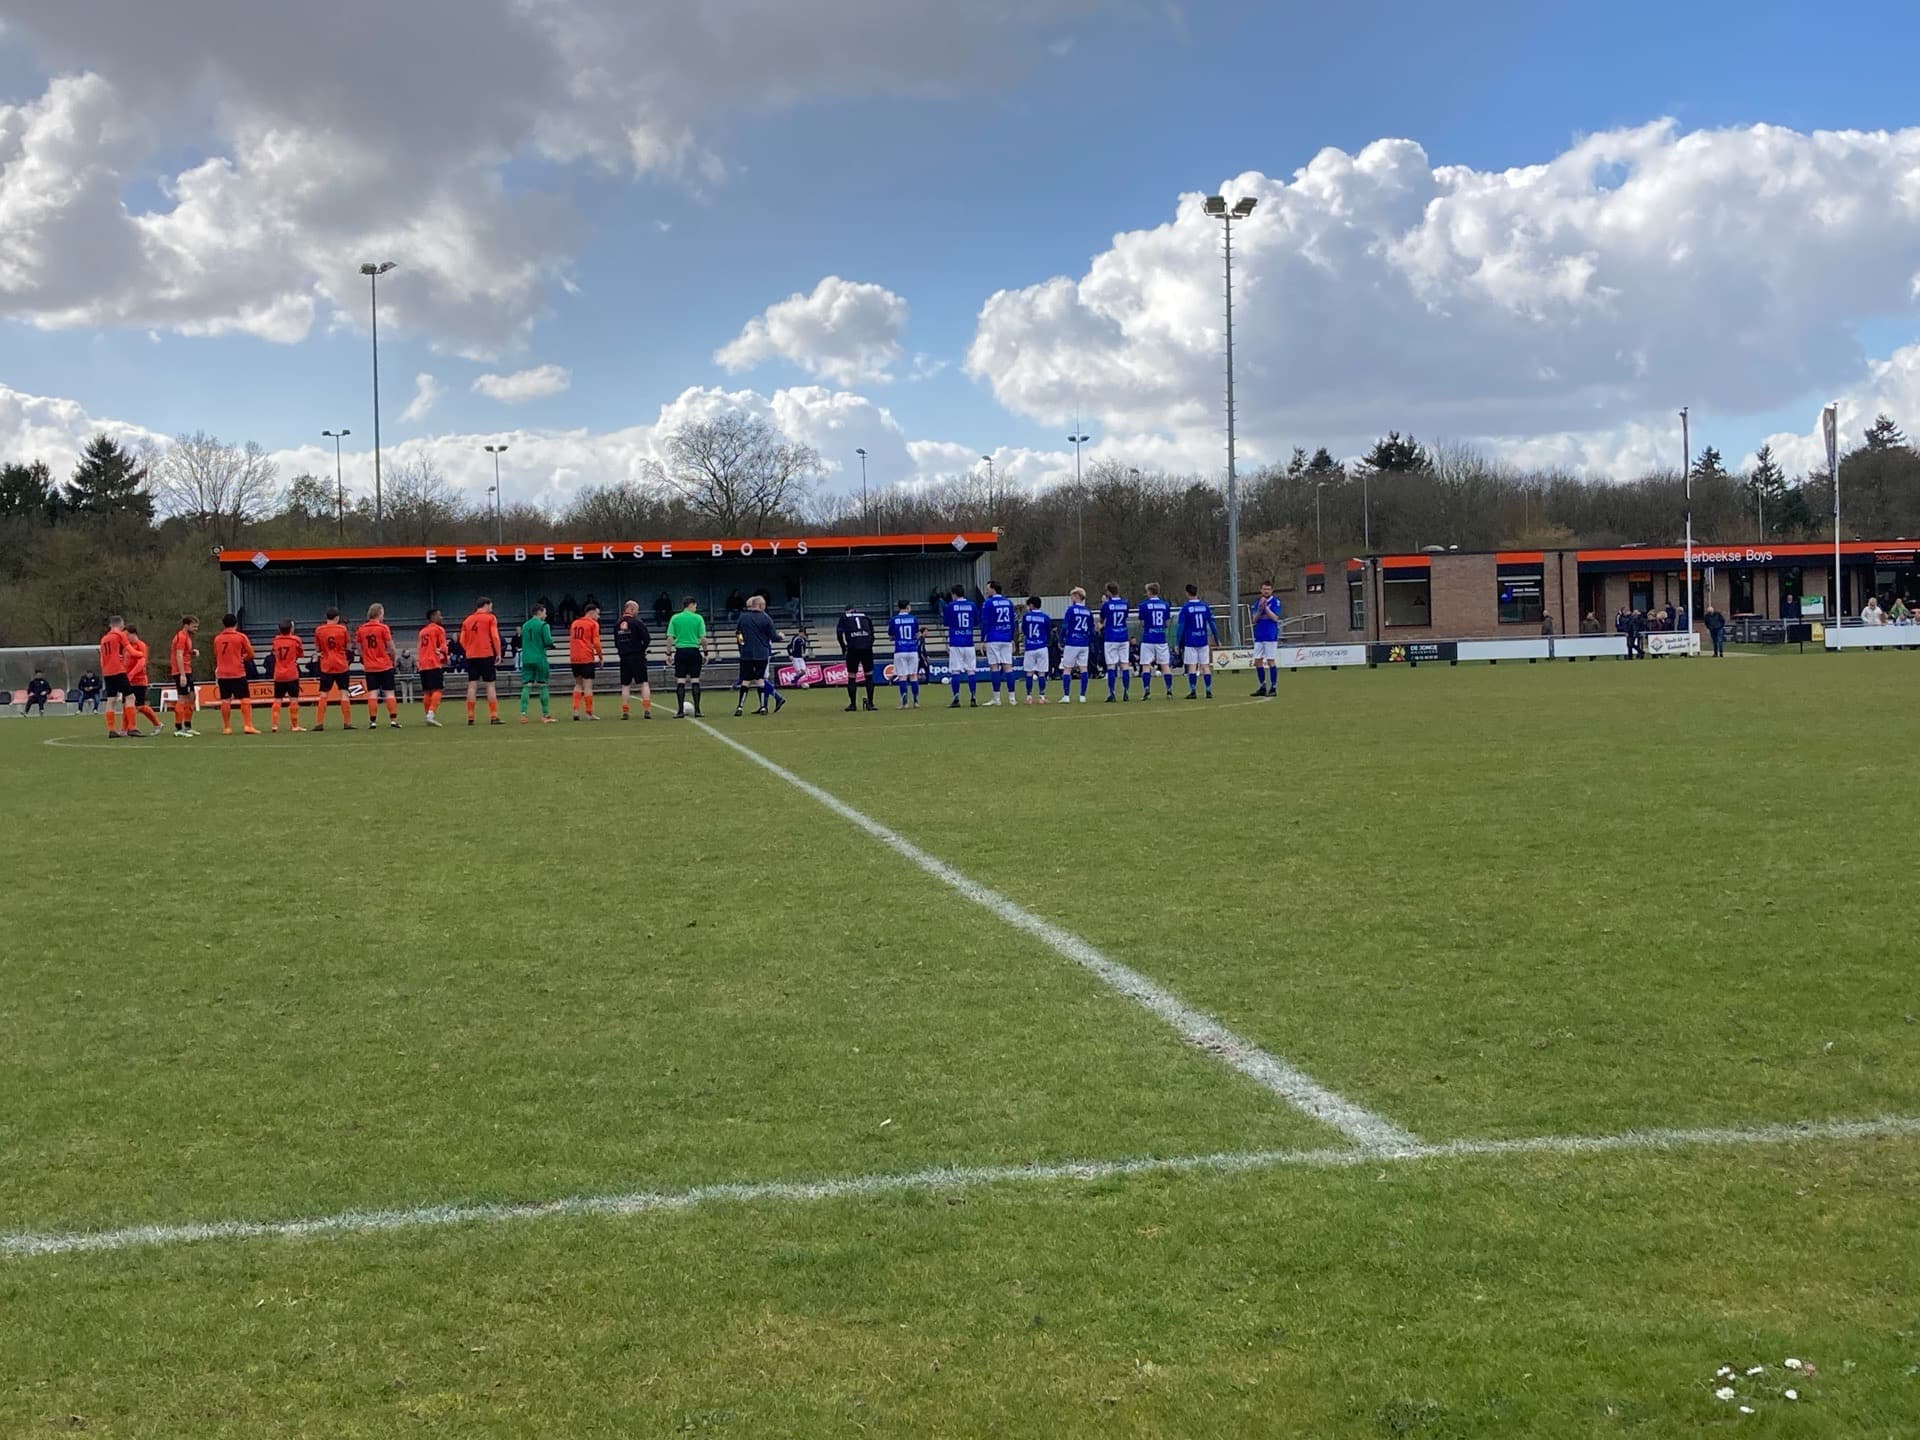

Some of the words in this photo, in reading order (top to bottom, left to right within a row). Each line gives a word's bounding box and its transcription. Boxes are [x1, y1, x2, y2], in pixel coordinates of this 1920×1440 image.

[425, 545, 673, 563] EERBEEKSE
[711, 541, 808, 556] BOYS
[1746, 549, 1773, 562] Boys
[957, 612, 969, 628] 16
[996, 607, 1010, 623] 23
[1113, 611, 1125, 627] 12
[1152, 611, 1164, 626] 18
[1195, 613, 1204, 629] 11
[471, 621, 478, 633] 4
[855, 616, 861, 630] 1
[1074, 616, 1089, 632] 24
[574, 626, 584, 640] 10
[899, 625, 912, 640] 10
[1029, 623, 1041, 639] 14
[103, 641, 112, 657] 11
[222, 641, 229, 655] 7
[327, 636, 336, 649] 6
[278, 646, 291, 660] 17
